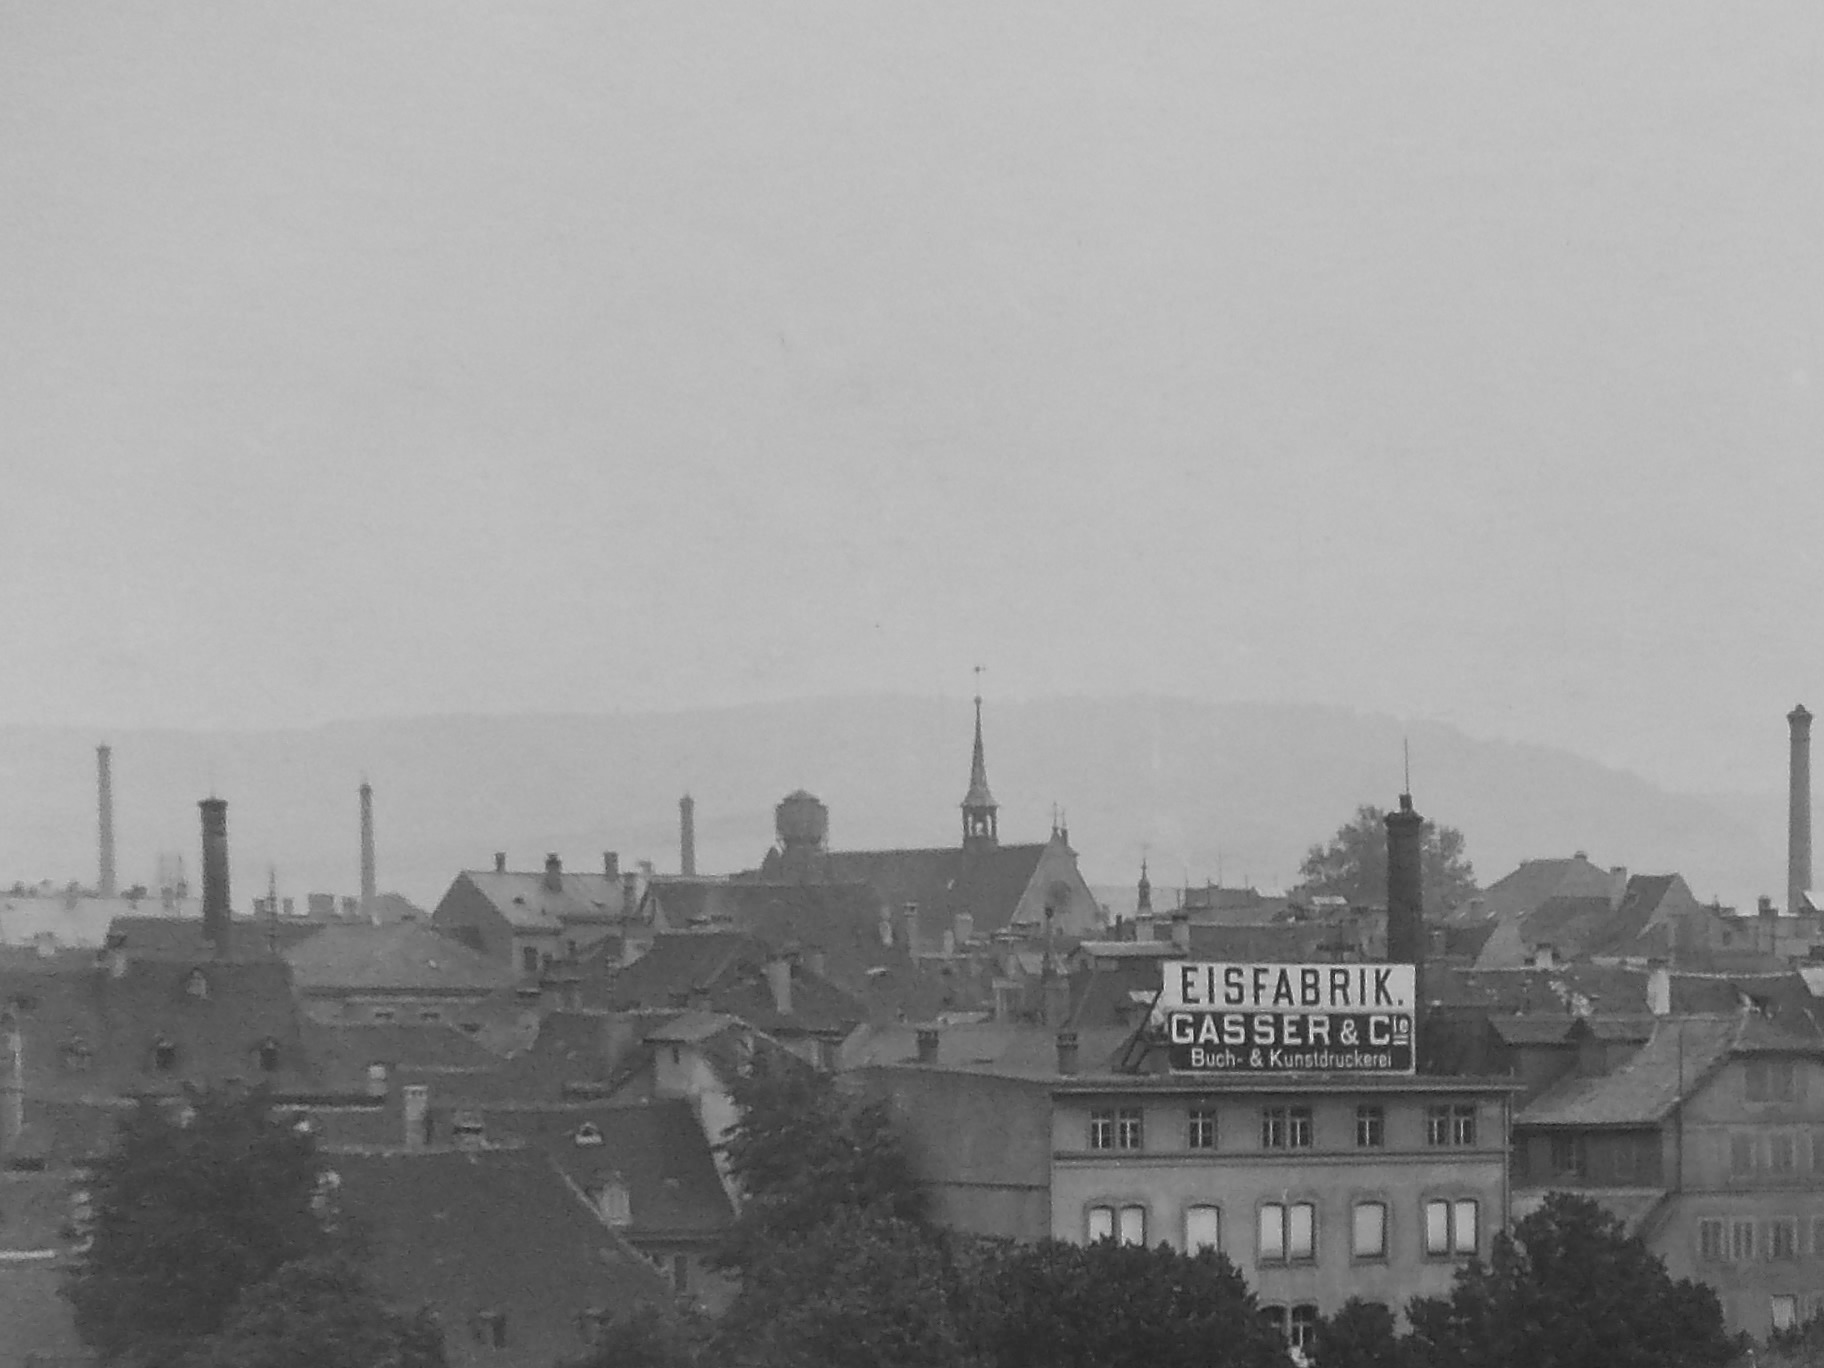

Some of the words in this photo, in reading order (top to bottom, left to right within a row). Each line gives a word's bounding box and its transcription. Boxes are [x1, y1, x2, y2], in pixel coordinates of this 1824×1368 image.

[1181, 966, 1404, 1006] EISFABRIK.
[1171, 1013, 1330, 1045] GASSER
[1340, 1019, 1359, 1045] &
[1191, 1047, 1243, 1068] Buch-
[1250, 1048, 1264, 1068] &
[1270, 1048, 1391, 1068] Kunstdruckerei
